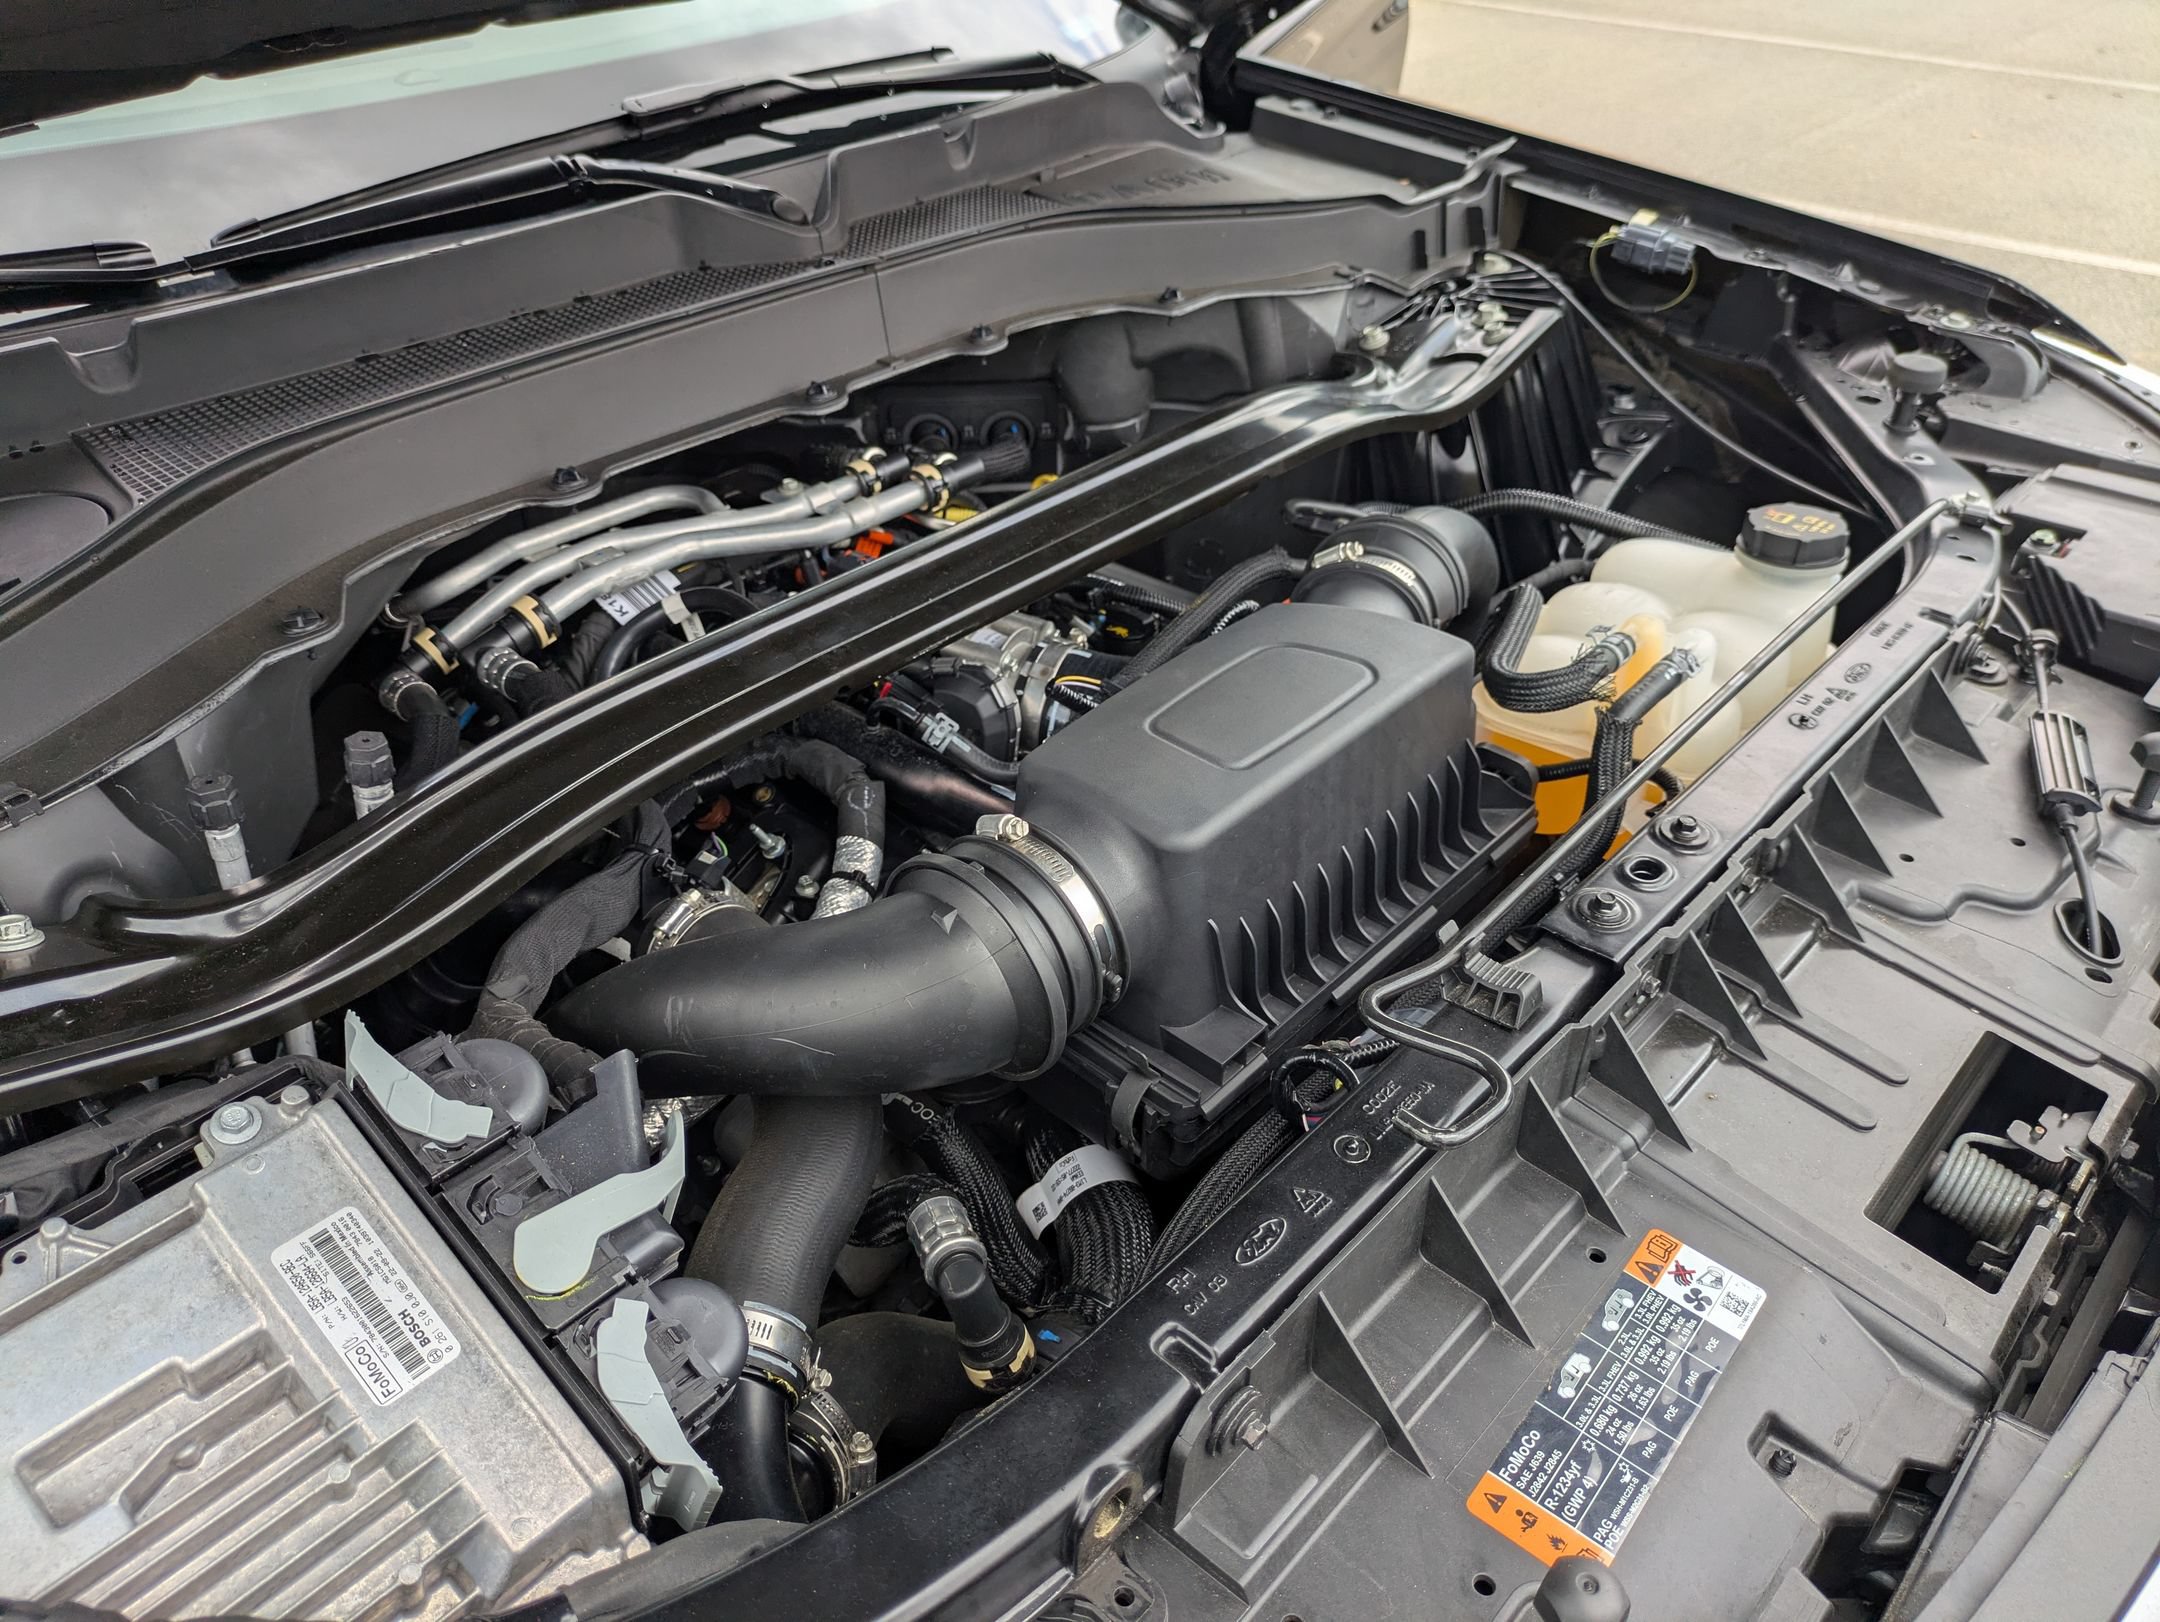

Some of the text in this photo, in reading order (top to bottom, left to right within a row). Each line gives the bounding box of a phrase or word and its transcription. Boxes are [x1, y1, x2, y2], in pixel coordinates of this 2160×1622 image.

[328, 1220, 347, 1241] Mexico
[347, 1245, 374, 1277] Assembled
[1165, 1267, 1197, 1294] RH
[1634, 1289, 1656, 1319] 3.3L FHEV
[1650, 1294, 1665, 1312] PHEV
[397, 1308, 431, 1348] BOSCH
[1655, 1302, 1680, 1332] 0.992 kg
[1670, 1316, 1685, 1332] 35 oz
[1678, 1318, 1696, 1341] 2.19 lbs
[431, 1327, 447, 1344] 261
[1632, 1326, 1644, 1340] 3.3L
[1705, 1336, 1718, 1352] POE
[1634, 1333, 1660, 1365] 0.992 kg
[1650, 1347, 1665, 1365] 35 oz
[1657, 1349, 1676, 1374] 2.19 lbs
[351, 1344, 396, 1399] FoMoCo
[1598, 1360, 1622, 1392] 3.3L FHEV
[1684, 1369, 1698, 1386] PAG
[1611, 1369, 1639, 1402] 0.737 kg
[1627, 1383, 1642, 1401] 26 oz
[1635, 1385, 1655, 1411] 1.63 lbs
[1575, 1393, 1601, 1427] 3.0L & 3.3L
[1589, 1403, 1617, 1436] 0.680 kg
[1663, 1404, 1678, 1421] POE
[1606, 1418, 1621, 1436] 24 oz
[1613, 1420, 1634, 1446] 1.50 lbs
[1498, 1427, 1541, 1482] FoMoCo
[1642, 1440, 1656, 1458] PAG
[1515, 1450, 1545, 1489] SAE J639
[1527, 1448, 1562, 1497] J2842 J2845
[1544, 1459, 1584, 1512] R-1234yf
[1561, 1475, 1598, 1522] (GWP 4)
[1593, 1518, 1613, 1542] PAG
[1604, 1525, 1624, 1549] POE
